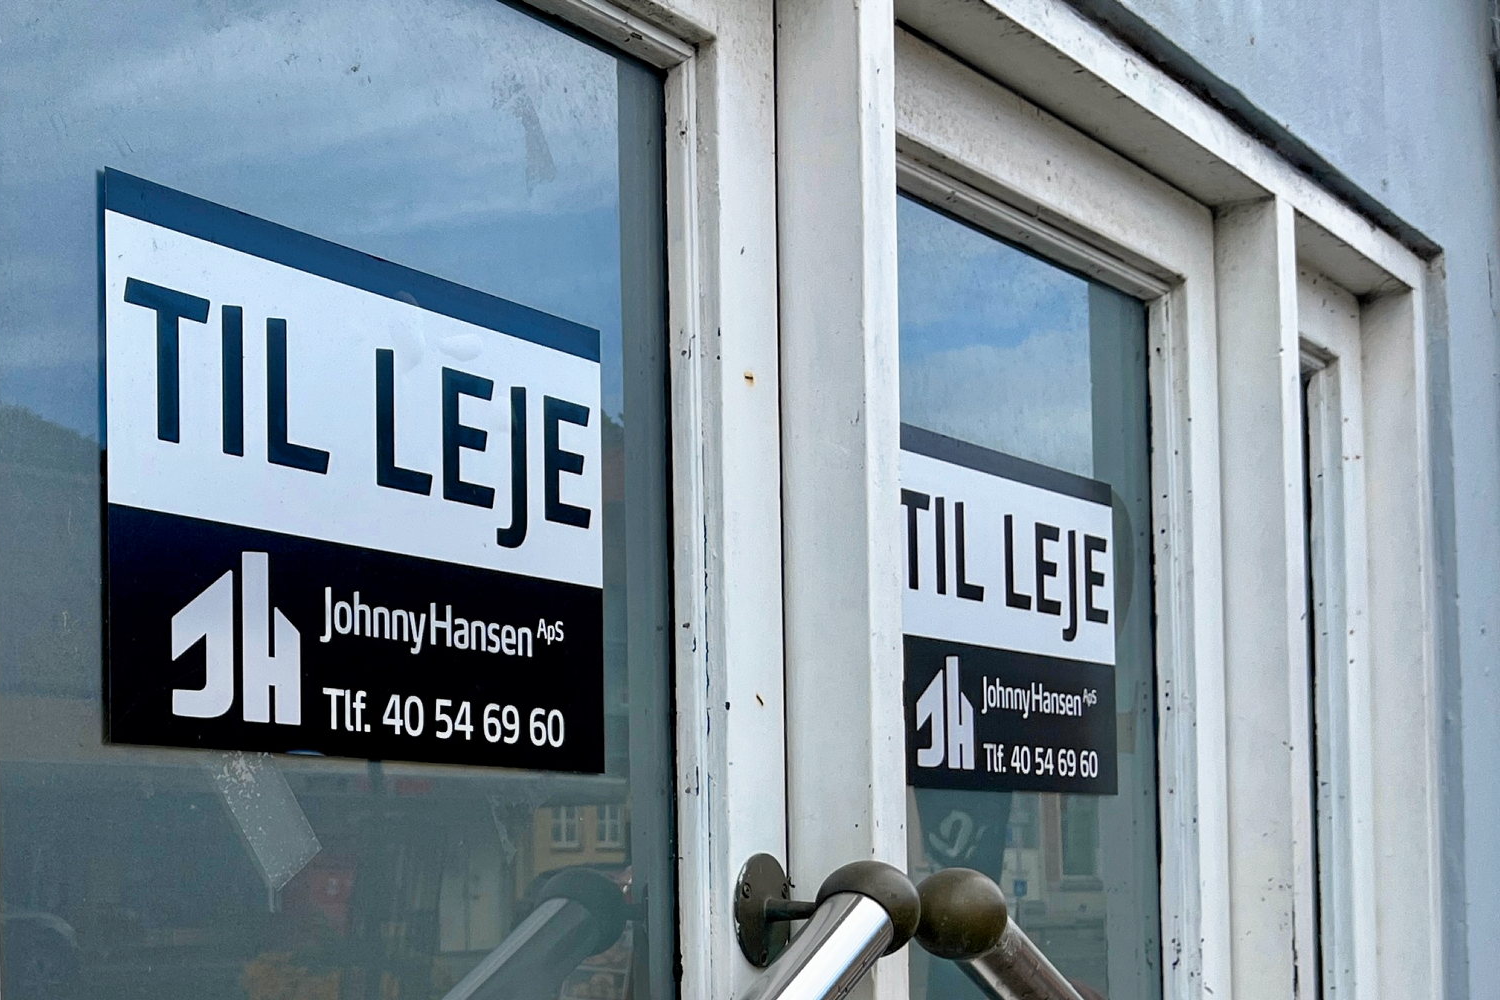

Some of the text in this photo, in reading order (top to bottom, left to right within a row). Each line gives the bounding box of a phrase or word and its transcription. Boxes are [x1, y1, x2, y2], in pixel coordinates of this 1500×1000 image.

[123, 276, 592, 549] TIL LEJE
[900, 487, 1109, 642] TIL LEJE
[536, 618, 565, 646] ApS
[322, 687, 565, 748] Tlf. 40 54 69 60
[983, 743, 1099, 779] Tlf. 40 54 69 60
